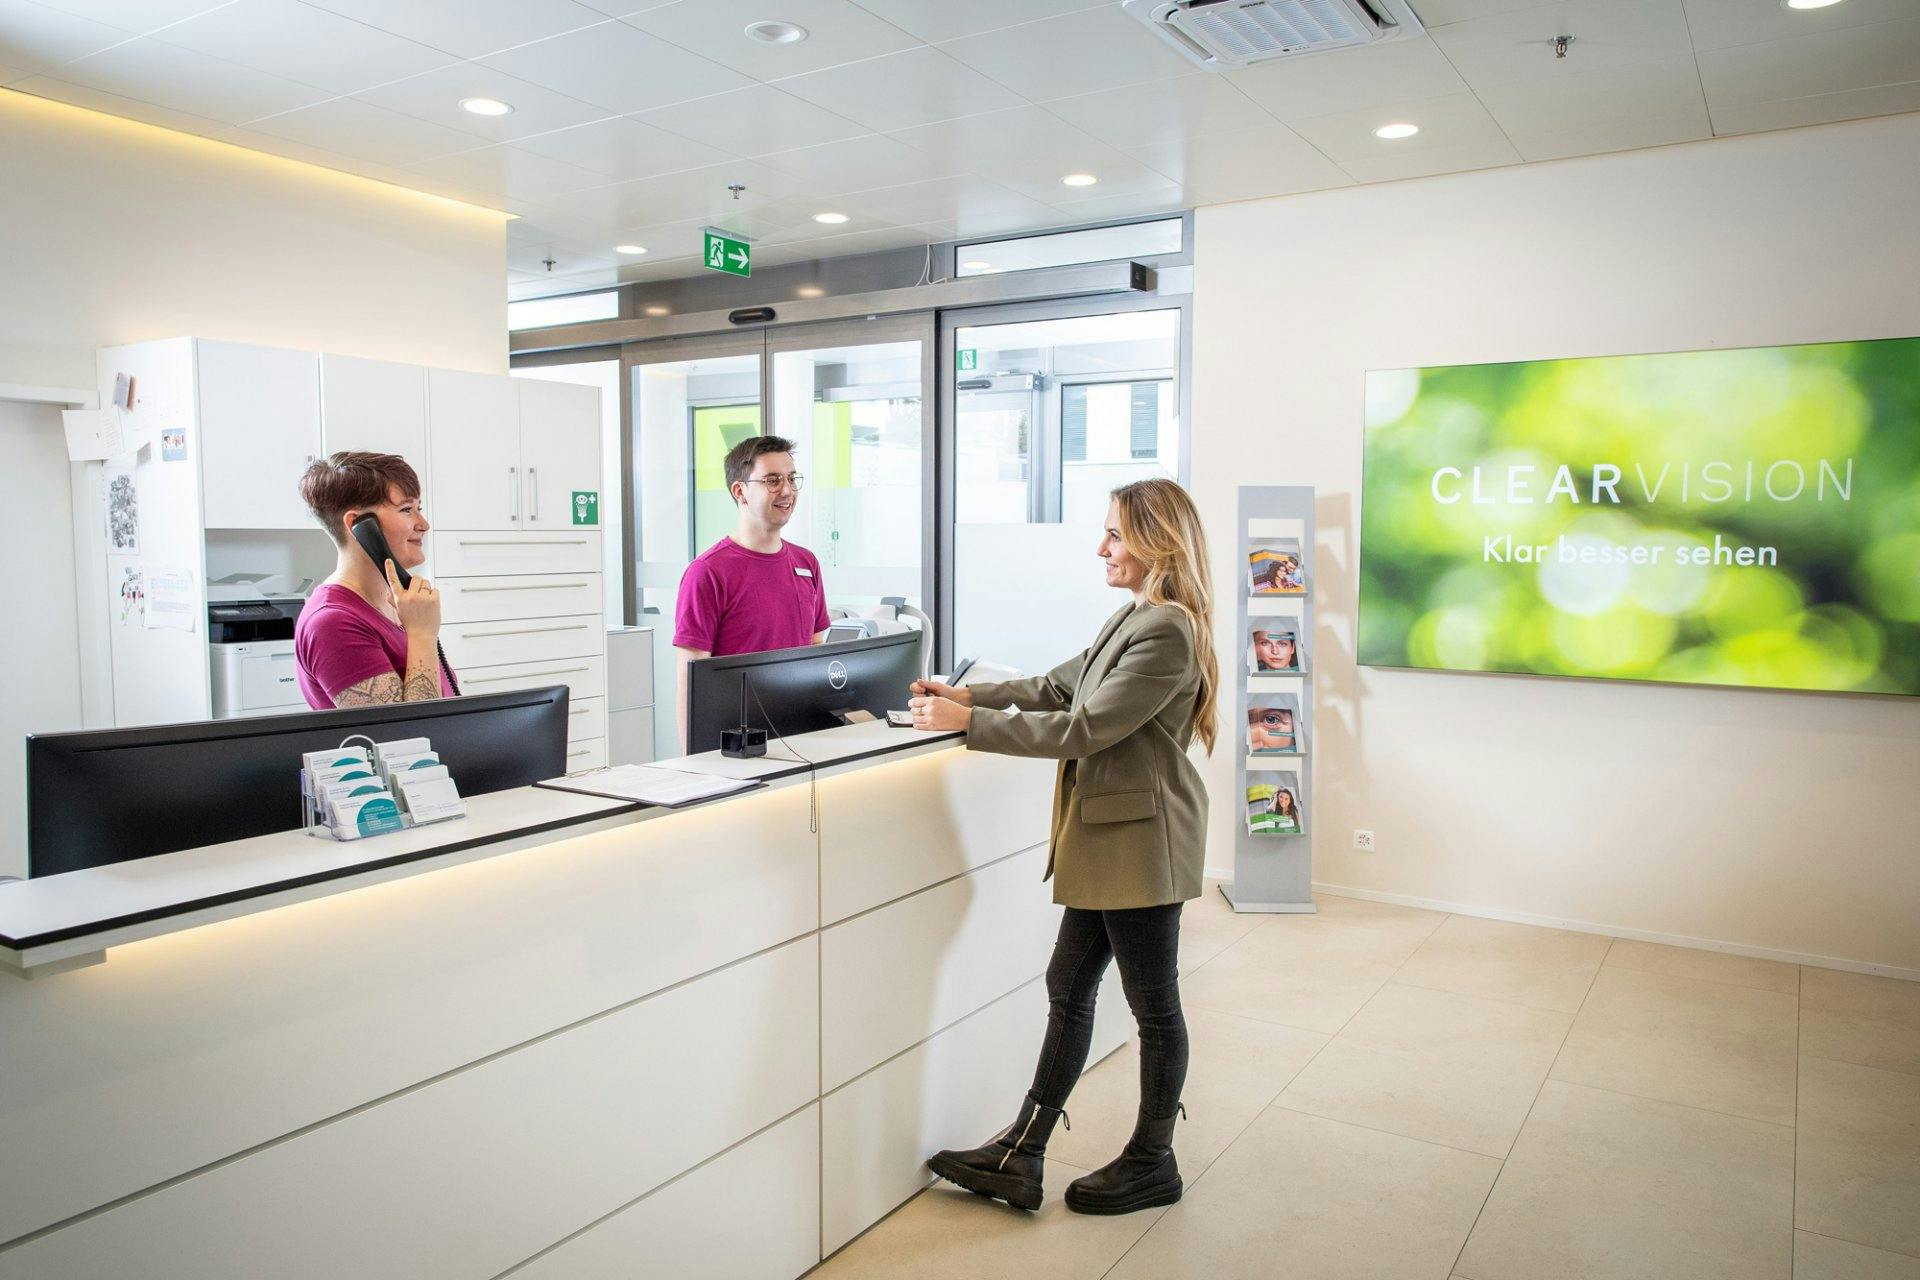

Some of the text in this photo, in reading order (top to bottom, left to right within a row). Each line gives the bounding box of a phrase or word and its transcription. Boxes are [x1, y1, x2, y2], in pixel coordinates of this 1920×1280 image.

[1483, 534, 1778, 567] Klar besser sehen
